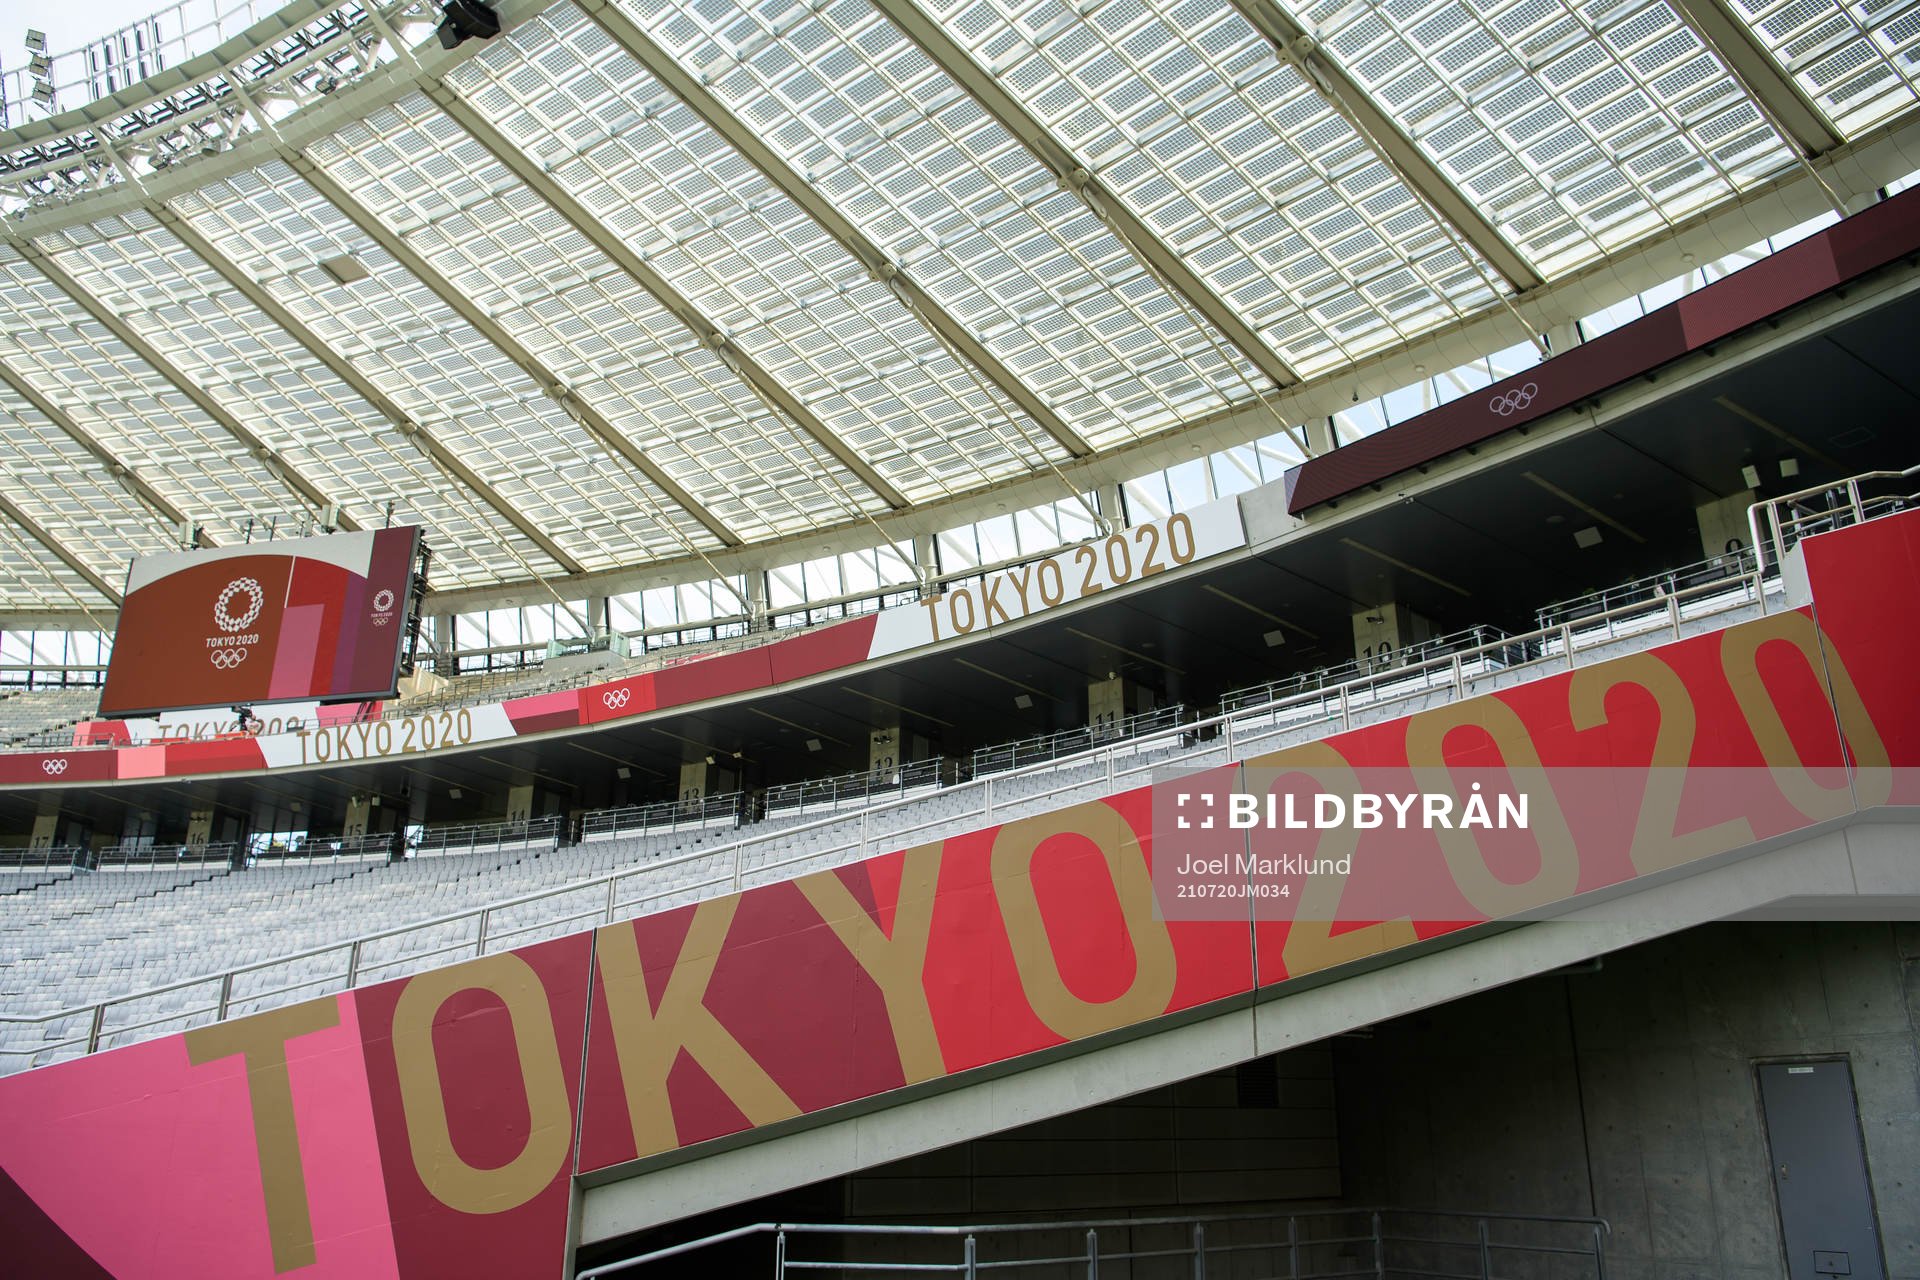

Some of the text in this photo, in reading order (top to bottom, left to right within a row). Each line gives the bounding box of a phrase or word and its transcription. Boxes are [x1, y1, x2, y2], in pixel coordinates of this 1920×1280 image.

[920, 512, 1195, 641] TOKYO 2020
[206, 633, 259, 648] TOKYO 2020
[1363, 641, 1392, 663] 10
[296, 707, 472, 767] TOKYO 2020
[184, 610, 1893, 1275] TOKYO 2020
